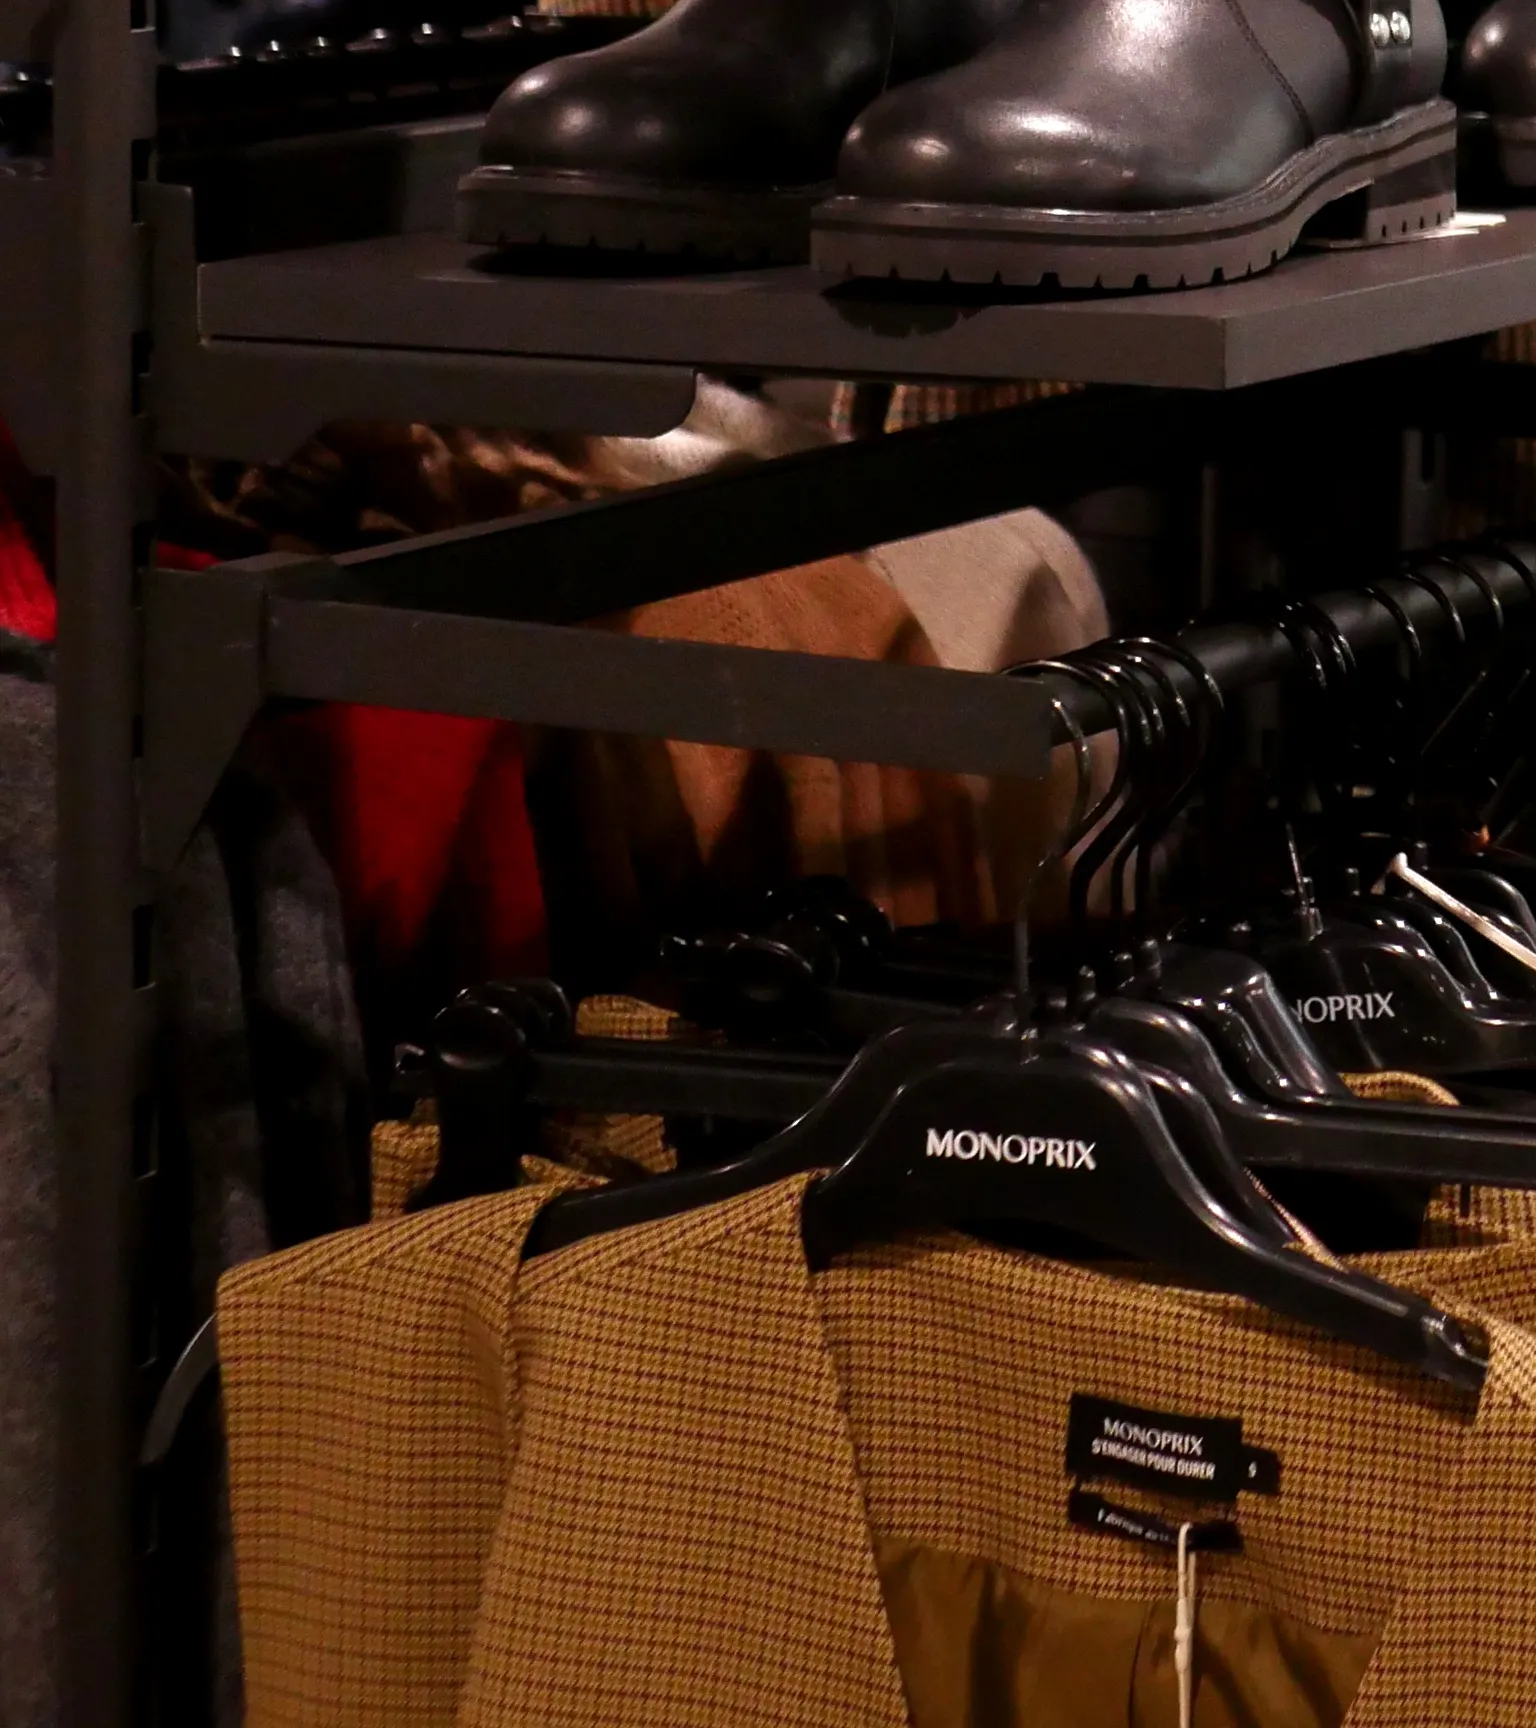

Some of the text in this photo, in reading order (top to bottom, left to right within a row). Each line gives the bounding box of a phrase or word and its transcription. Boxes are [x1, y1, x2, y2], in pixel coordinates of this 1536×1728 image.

[1290, 992, 1395, 1023] NOPRIX
[926, 1128, 1097, 1170] MONOPRIX
[1103, 1417, 1204, 1456] MONOPRIX
[1146, 1452, 1176, 1473] POUR
[1177, 1460, 1216, 1480] DURER
